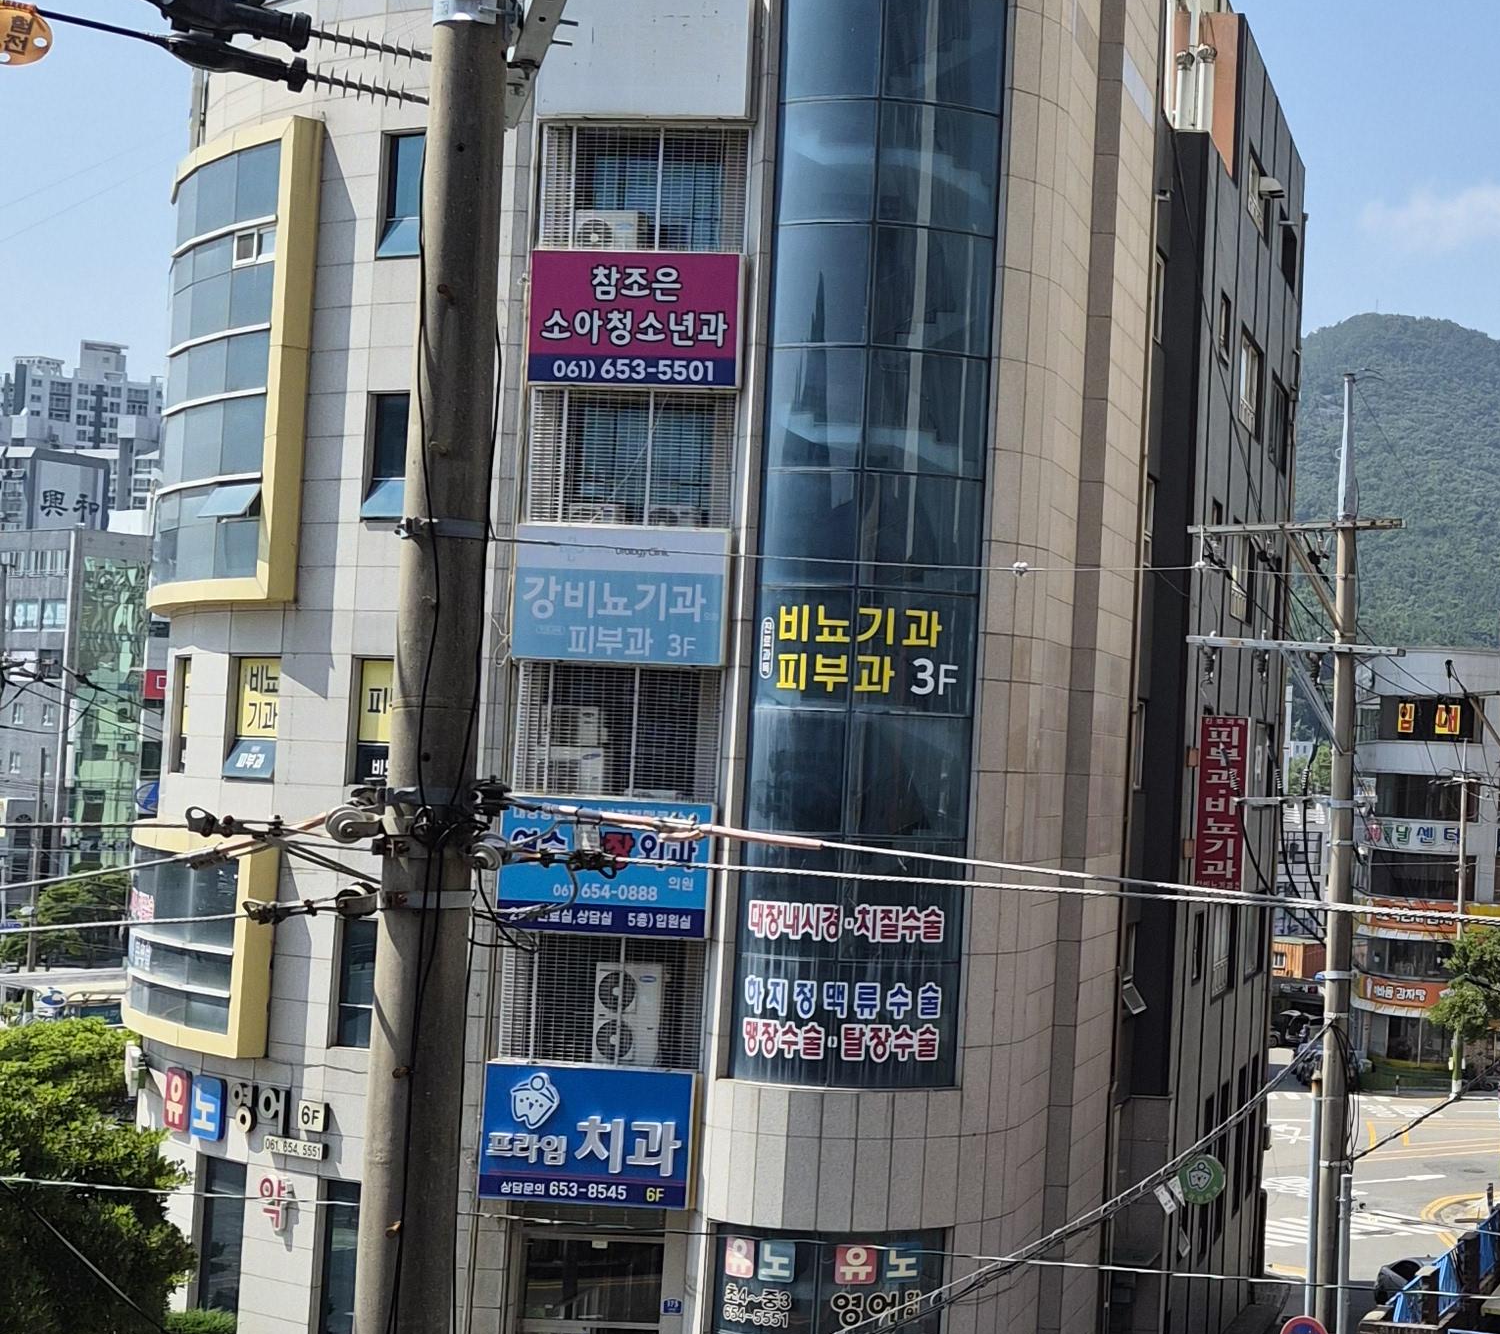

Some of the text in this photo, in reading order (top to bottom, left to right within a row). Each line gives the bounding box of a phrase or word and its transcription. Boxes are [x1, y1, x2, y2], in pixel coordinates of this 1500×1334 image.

[591, 265, 682, 302] 참조은
[540, 309, 728, 348] 소아청소년과
[552, 359, 714, 382] 061) 653-5501
[523, 576, 706, 622] 강비뇨기과
[567, 625, 697, 657] 피부과 3F
[779, 604, 943, 648] 비뇨기과
[776, 653, 959, 696] 피부과 3F
[581, 883, 658, 901] 654-0888
[668, 876, 694, 891] 의원
[745, 974, 942, 1019] 하지정맥류수술
[166, 1075, 320, 1135] 유노 영어 6F
[302, 1145, 321, 1158] 5551
[486, 1115, 682, 1177] 프라임 치과
[260, 1175, 286, 1229] 약
[500, 1180, 665, 1203] 상담문의 653-8545 6F
[727, 1237, 791, 1278] 유노
[839, 1246, 919, 1281] 유노
[722, 1305, 790, 1328] 654-5551
[831, 1292, 899, 1328] 영어
